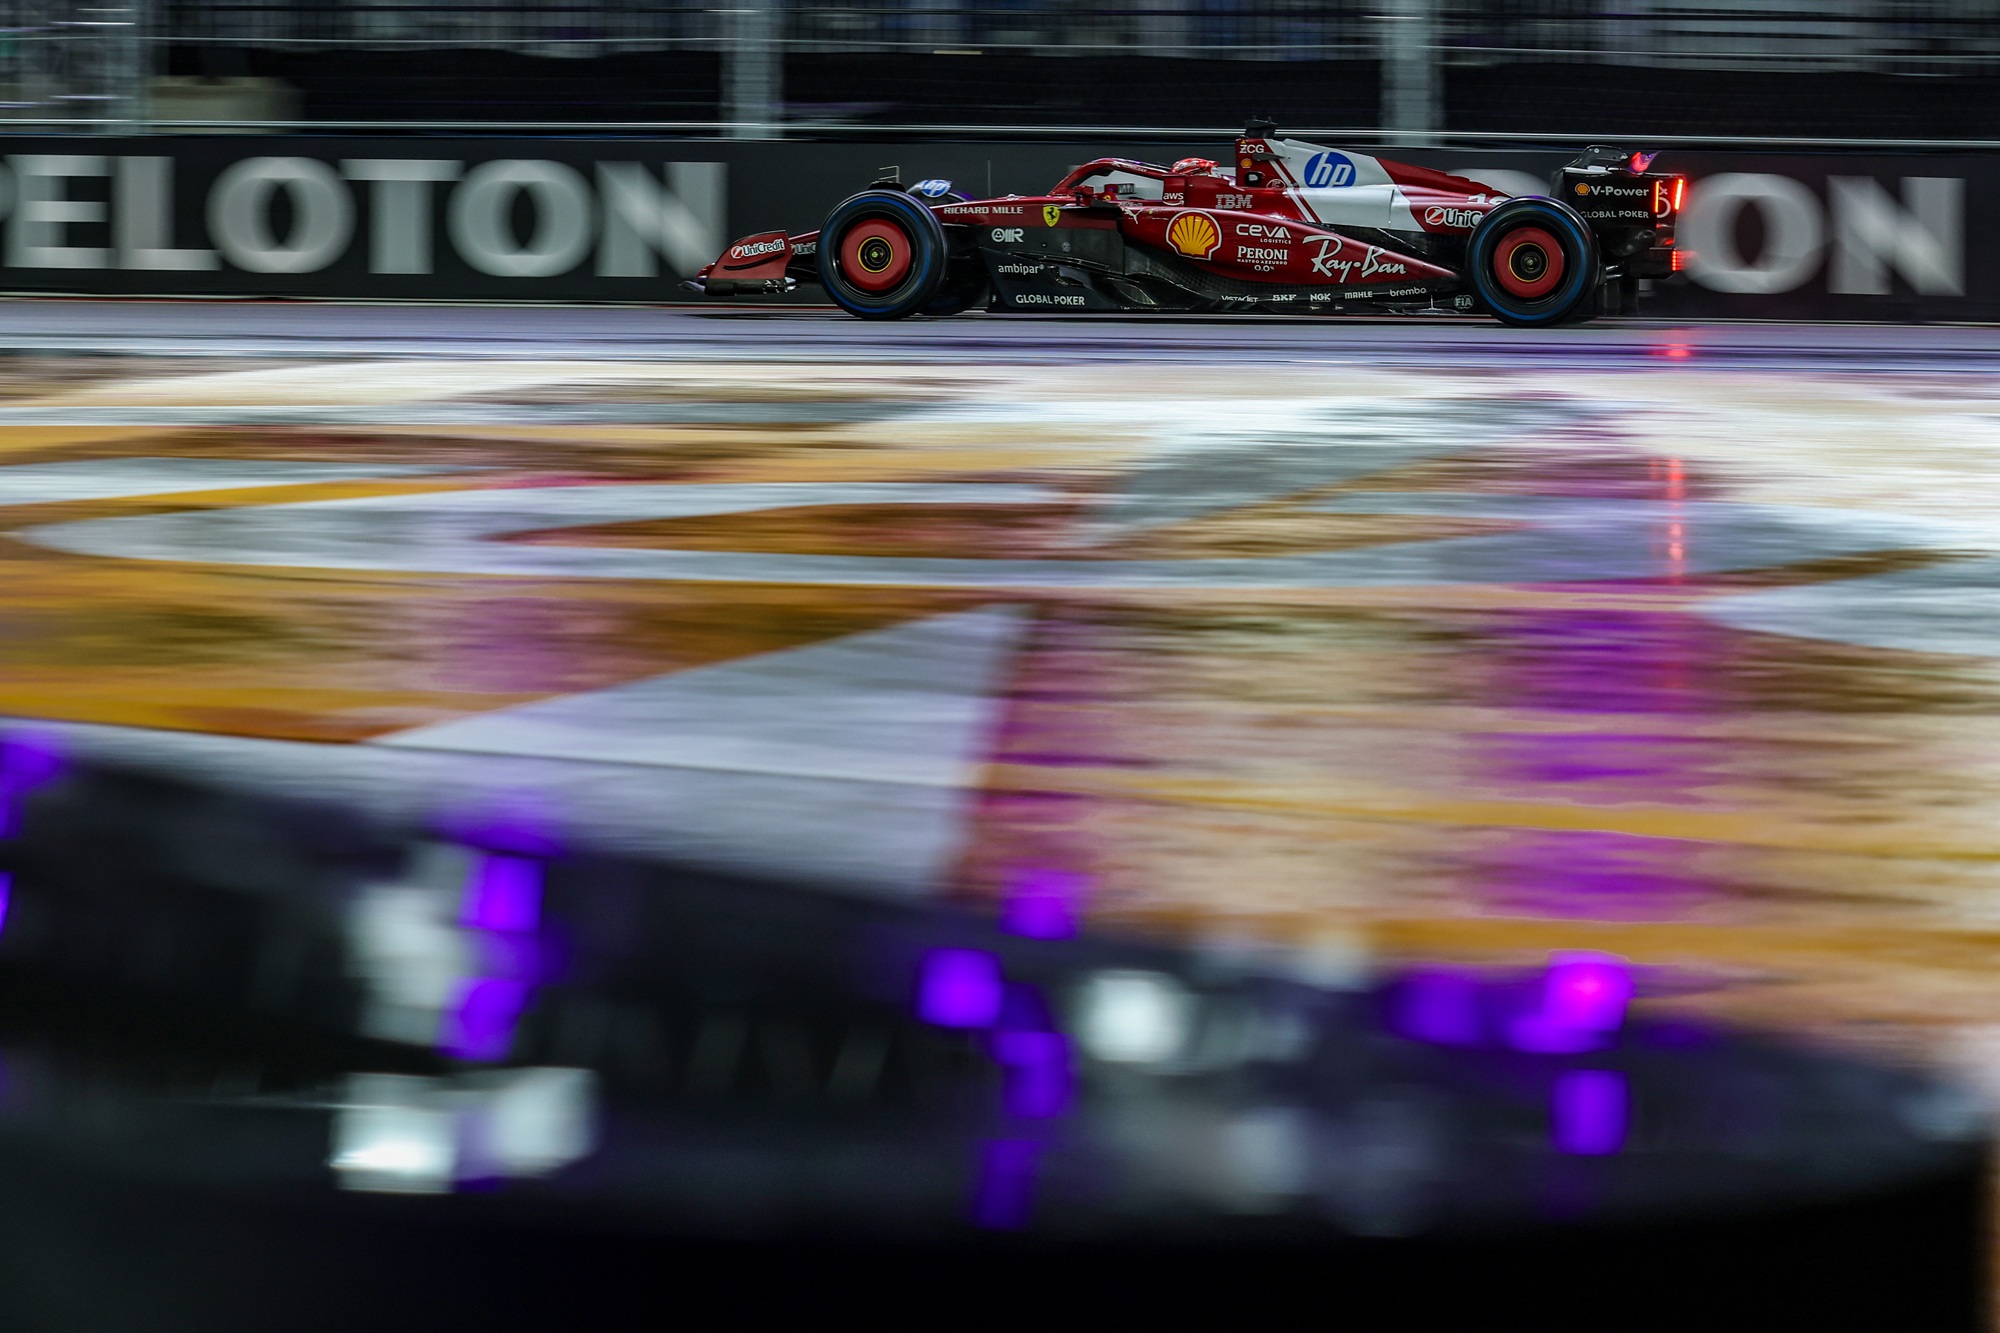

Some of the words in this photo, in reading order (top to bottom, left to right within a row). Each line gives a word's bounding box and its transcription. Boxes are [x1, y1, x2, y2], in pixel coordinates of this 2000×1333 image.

[1239, 144, 1265, 154] ZCG
[1309, 153, 1351, 186] hp
[1163, 192, 1184, 200] aws
[1590, 185, 1650, 197] V-Power
[1215, 194, 1253, 209] IBM
[943, 206, 989, 214] RICHARD
[991, 206, 1023, 214] MILLE
[1580, 210, 1617, 218] GLOBAL
[1618, 210, 1649, 218] POKER
[742, 240, 784, 256] UniCredit
[1237, 245, 1288, 260] PERONI
[998, 263, 1039, 275] ambipar
[1344, 291, 1373, 299] MAHLE
[1389, 286, 1427, 297] brembo
[1015, 294, 1053, 304] GLOBAL
[1054, 295, 1085, 305] POKER
[1272, 294, 1297, 302] SKF
[1310, 293, 1331, 301] NGK
[1455, 297, 1471, 306] FIA
